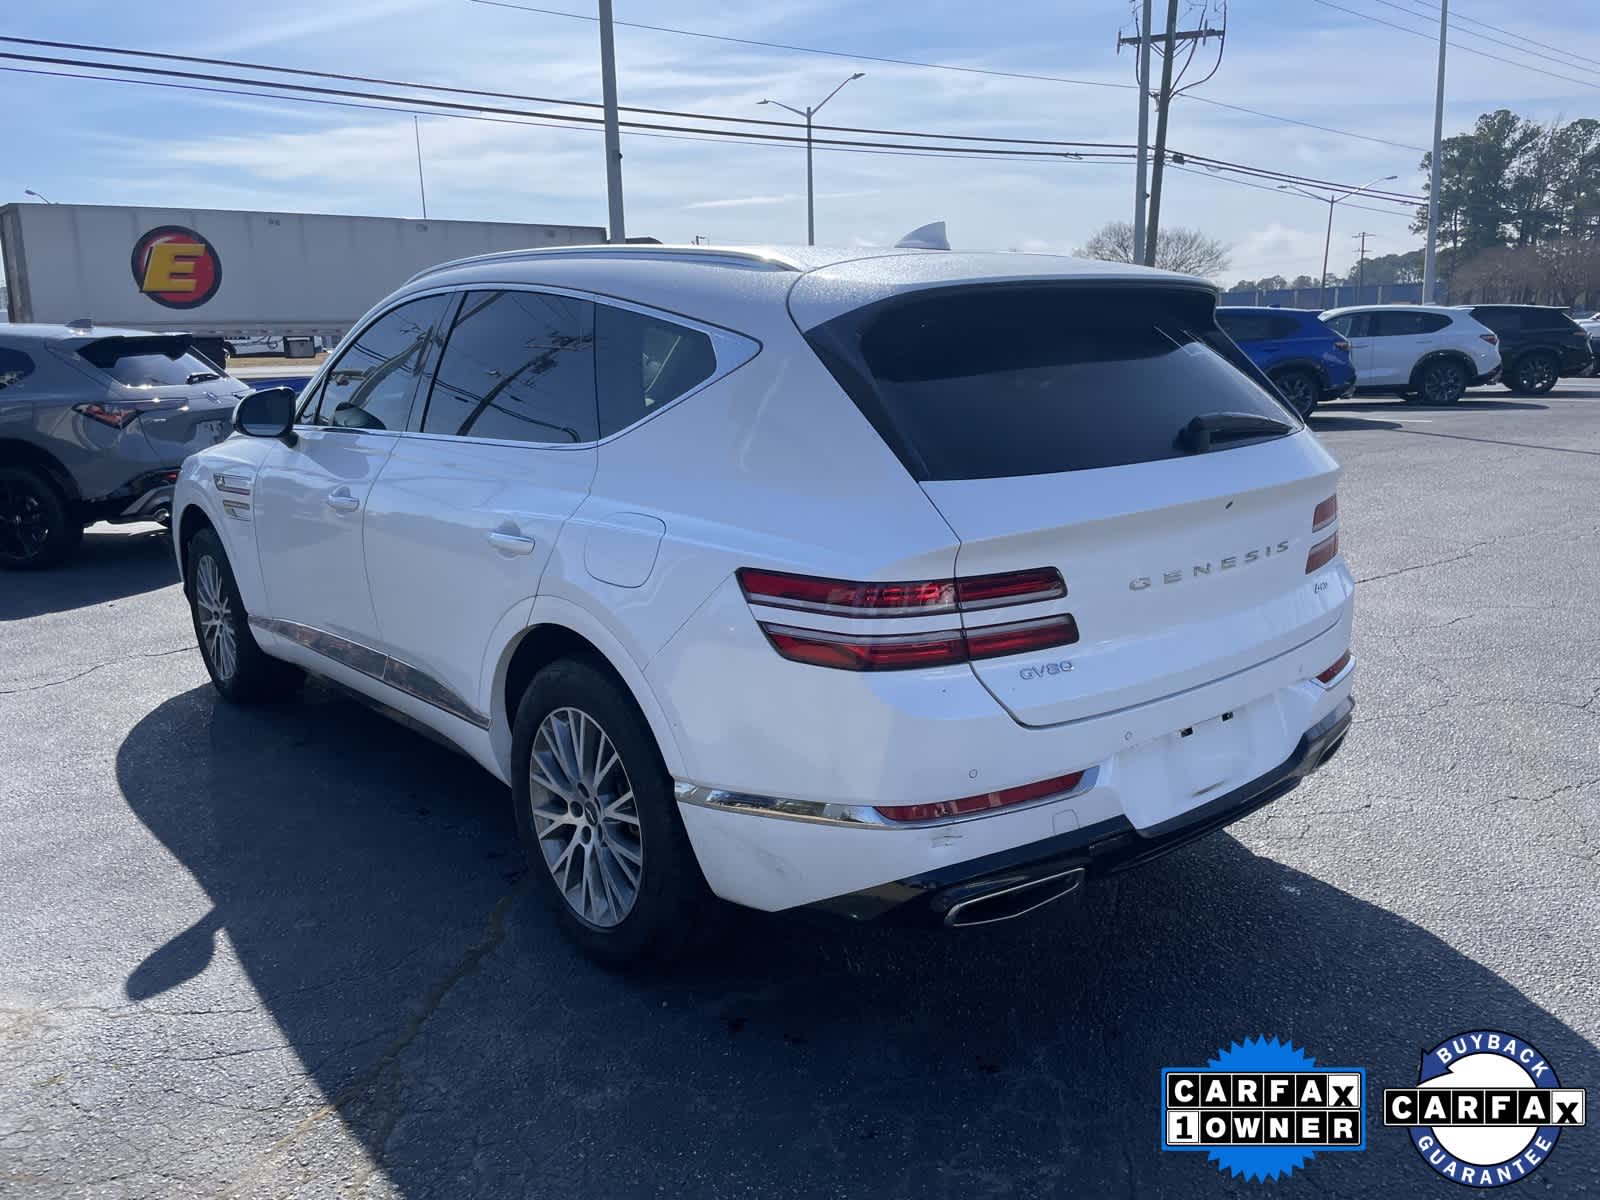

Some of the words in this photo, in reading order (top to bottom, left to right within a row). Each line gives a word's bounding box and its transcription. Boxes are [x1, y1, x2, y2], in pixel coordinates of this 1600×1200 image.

[140, 243, 206, 293] E
[1129, 540, 1289, 592] GENESIS
[1019, 660, 1074, 681] GV80
